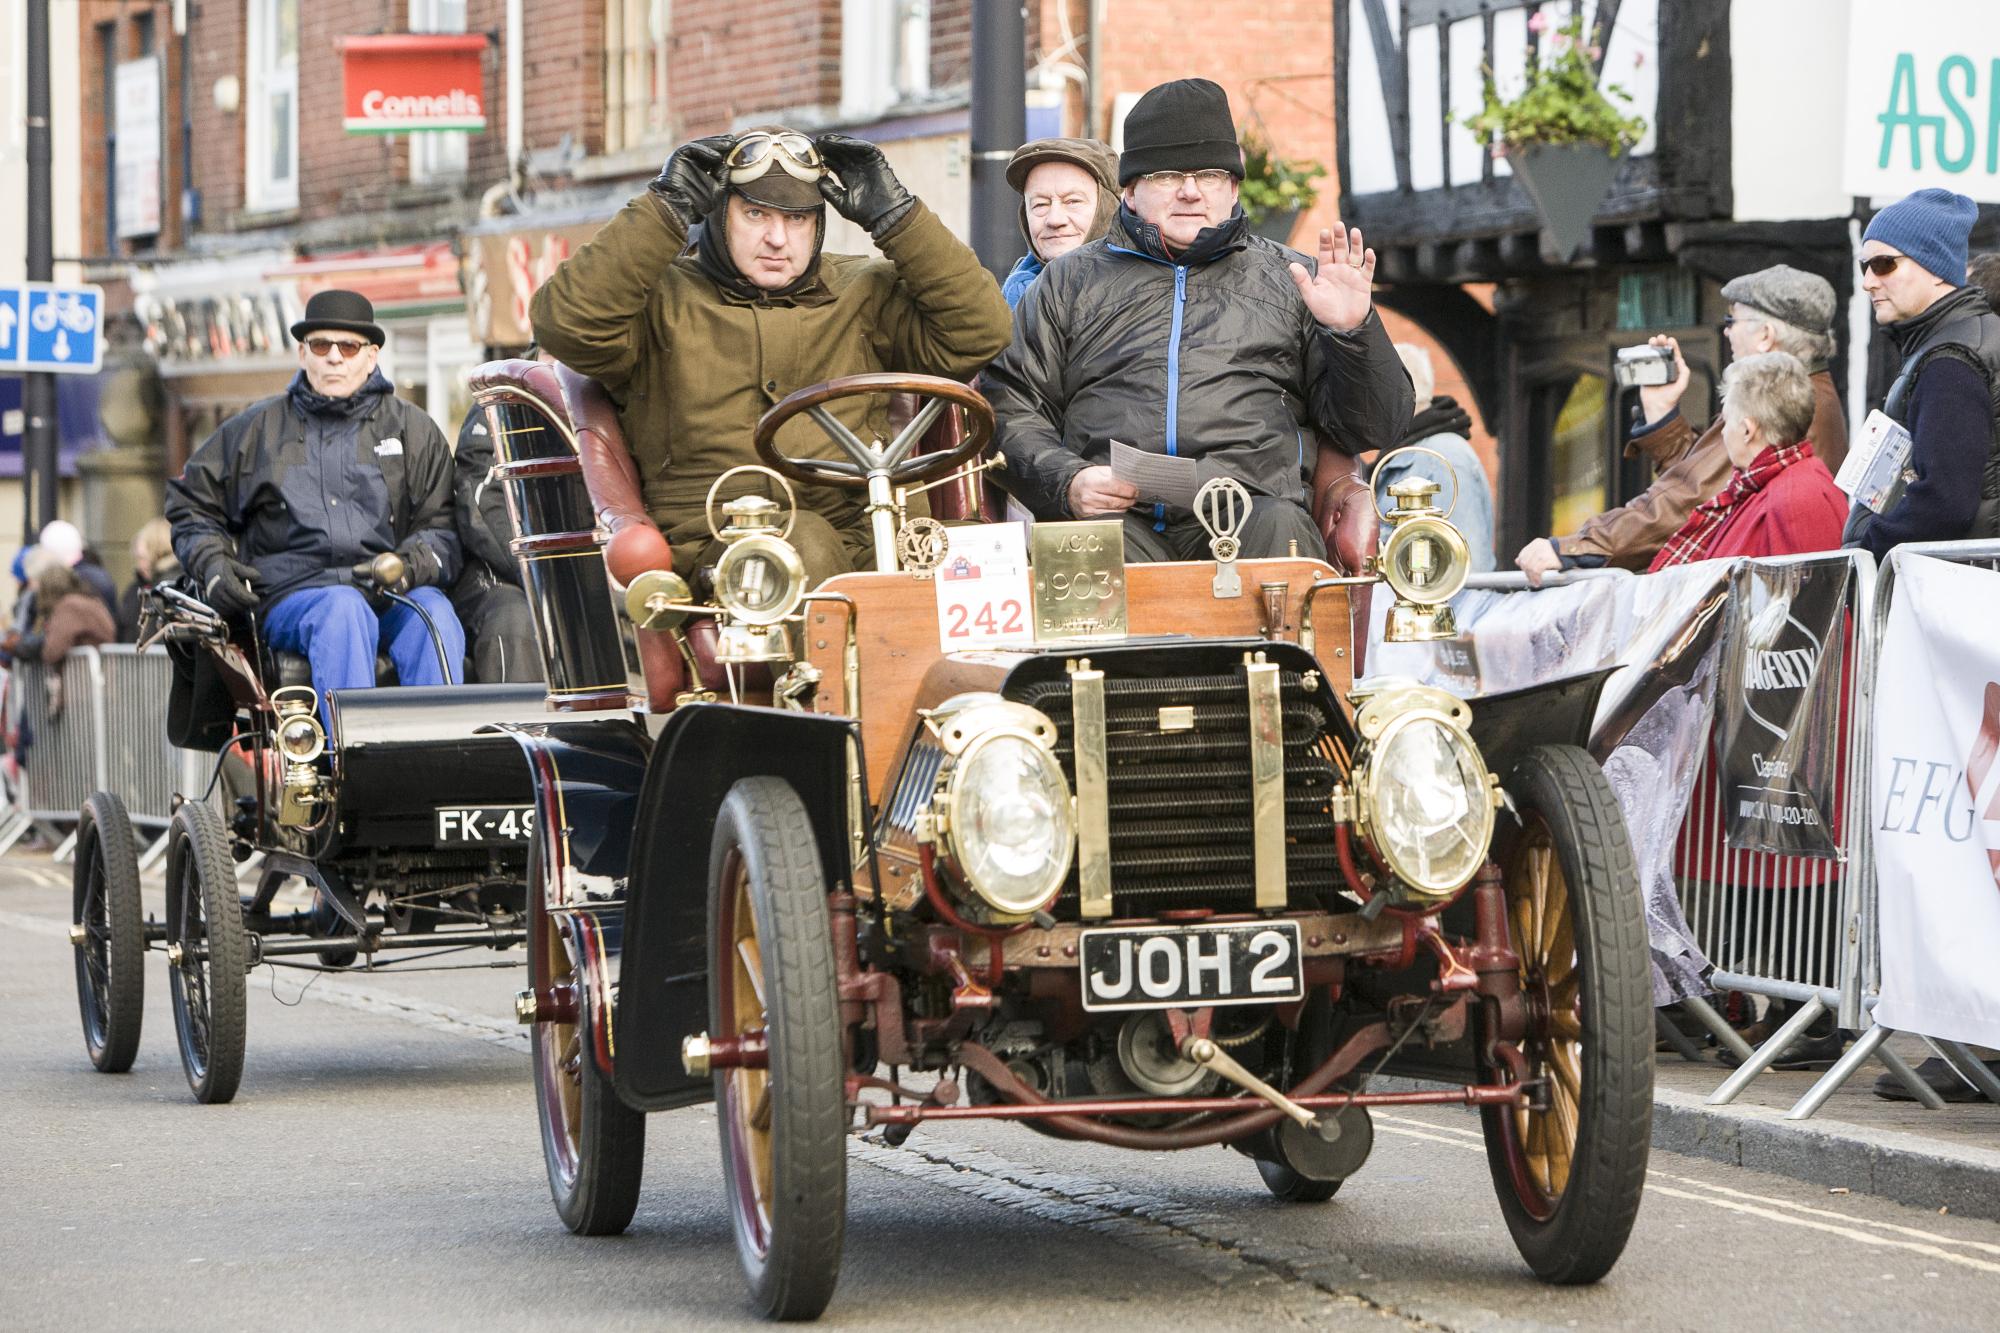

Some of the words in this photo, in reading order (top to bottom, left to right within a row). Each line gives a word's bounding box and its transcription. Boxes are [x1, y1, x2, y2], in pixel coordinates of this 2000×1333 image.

[362, 88, 481, 118] Connells
[1044, 571, 1115, 602] 1903
[946, 598, 1025, 639] 242
[1744, 647, 1815, 691] HAGERTY
[1879, 756, 1976, 843] EFG
[1090, 933, 1232, 1000] JOH
[1248, 929, 1295, 994] 2
